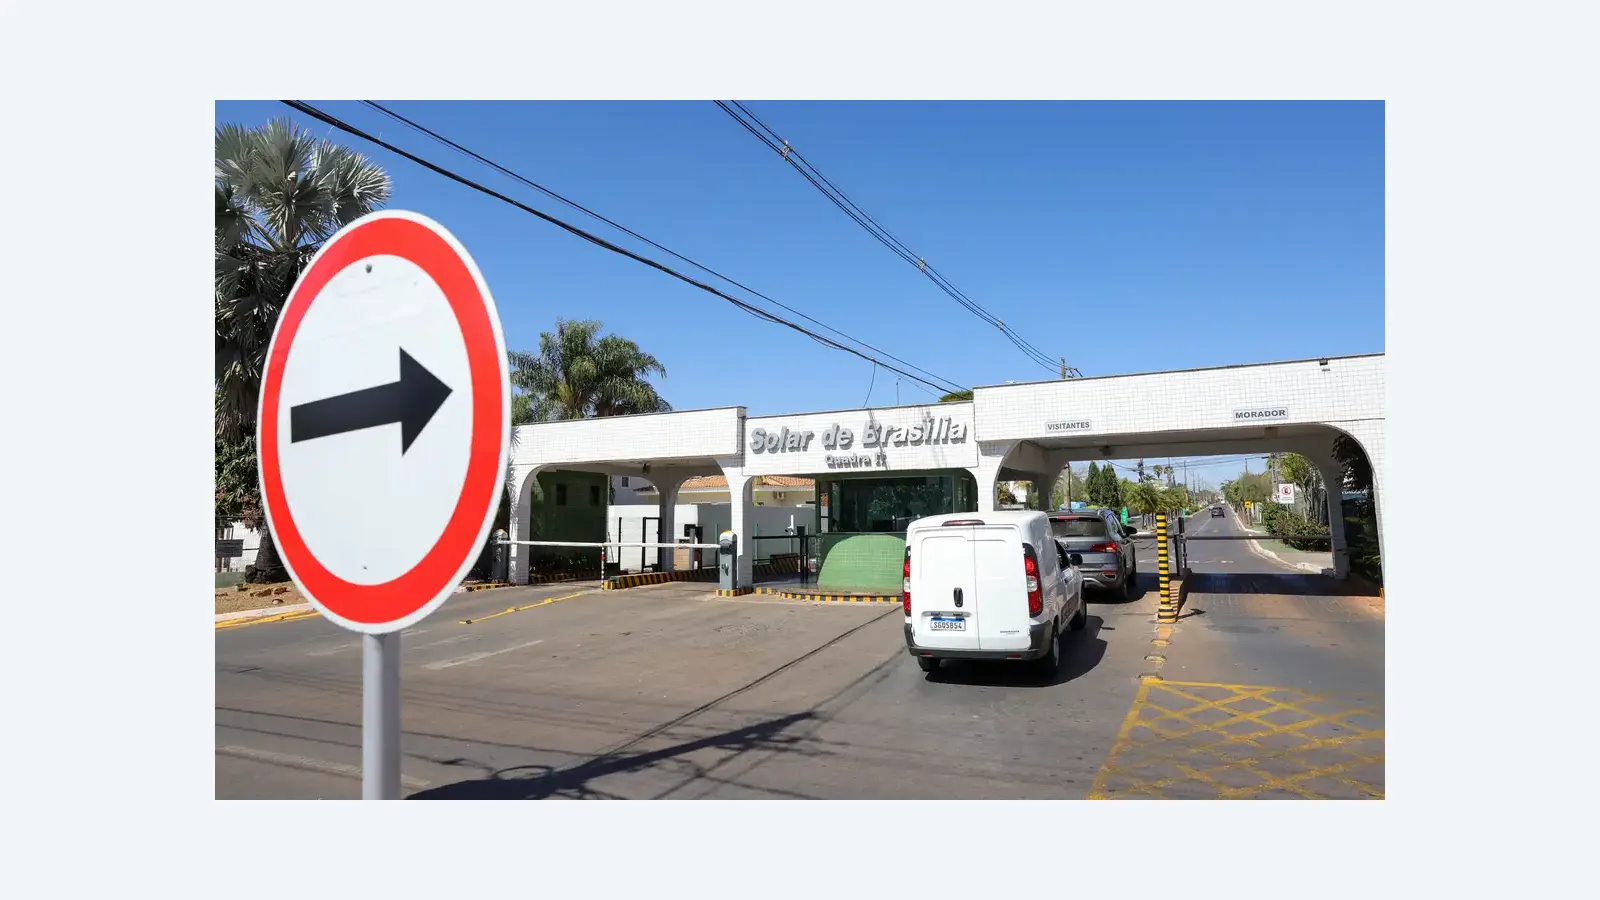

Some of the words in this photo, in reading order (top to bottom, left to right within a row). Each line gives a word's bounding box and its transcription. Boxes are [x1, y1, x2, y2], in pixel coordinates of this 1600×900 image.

[1235, 409, 1286, 419] MORADOR
[1047, 421, 1090, 431] VISITANTES
[750, 427, 815, 454] Solar
[821, 423, 854, 450] de
[825, 453, 872, 469] Quadra
